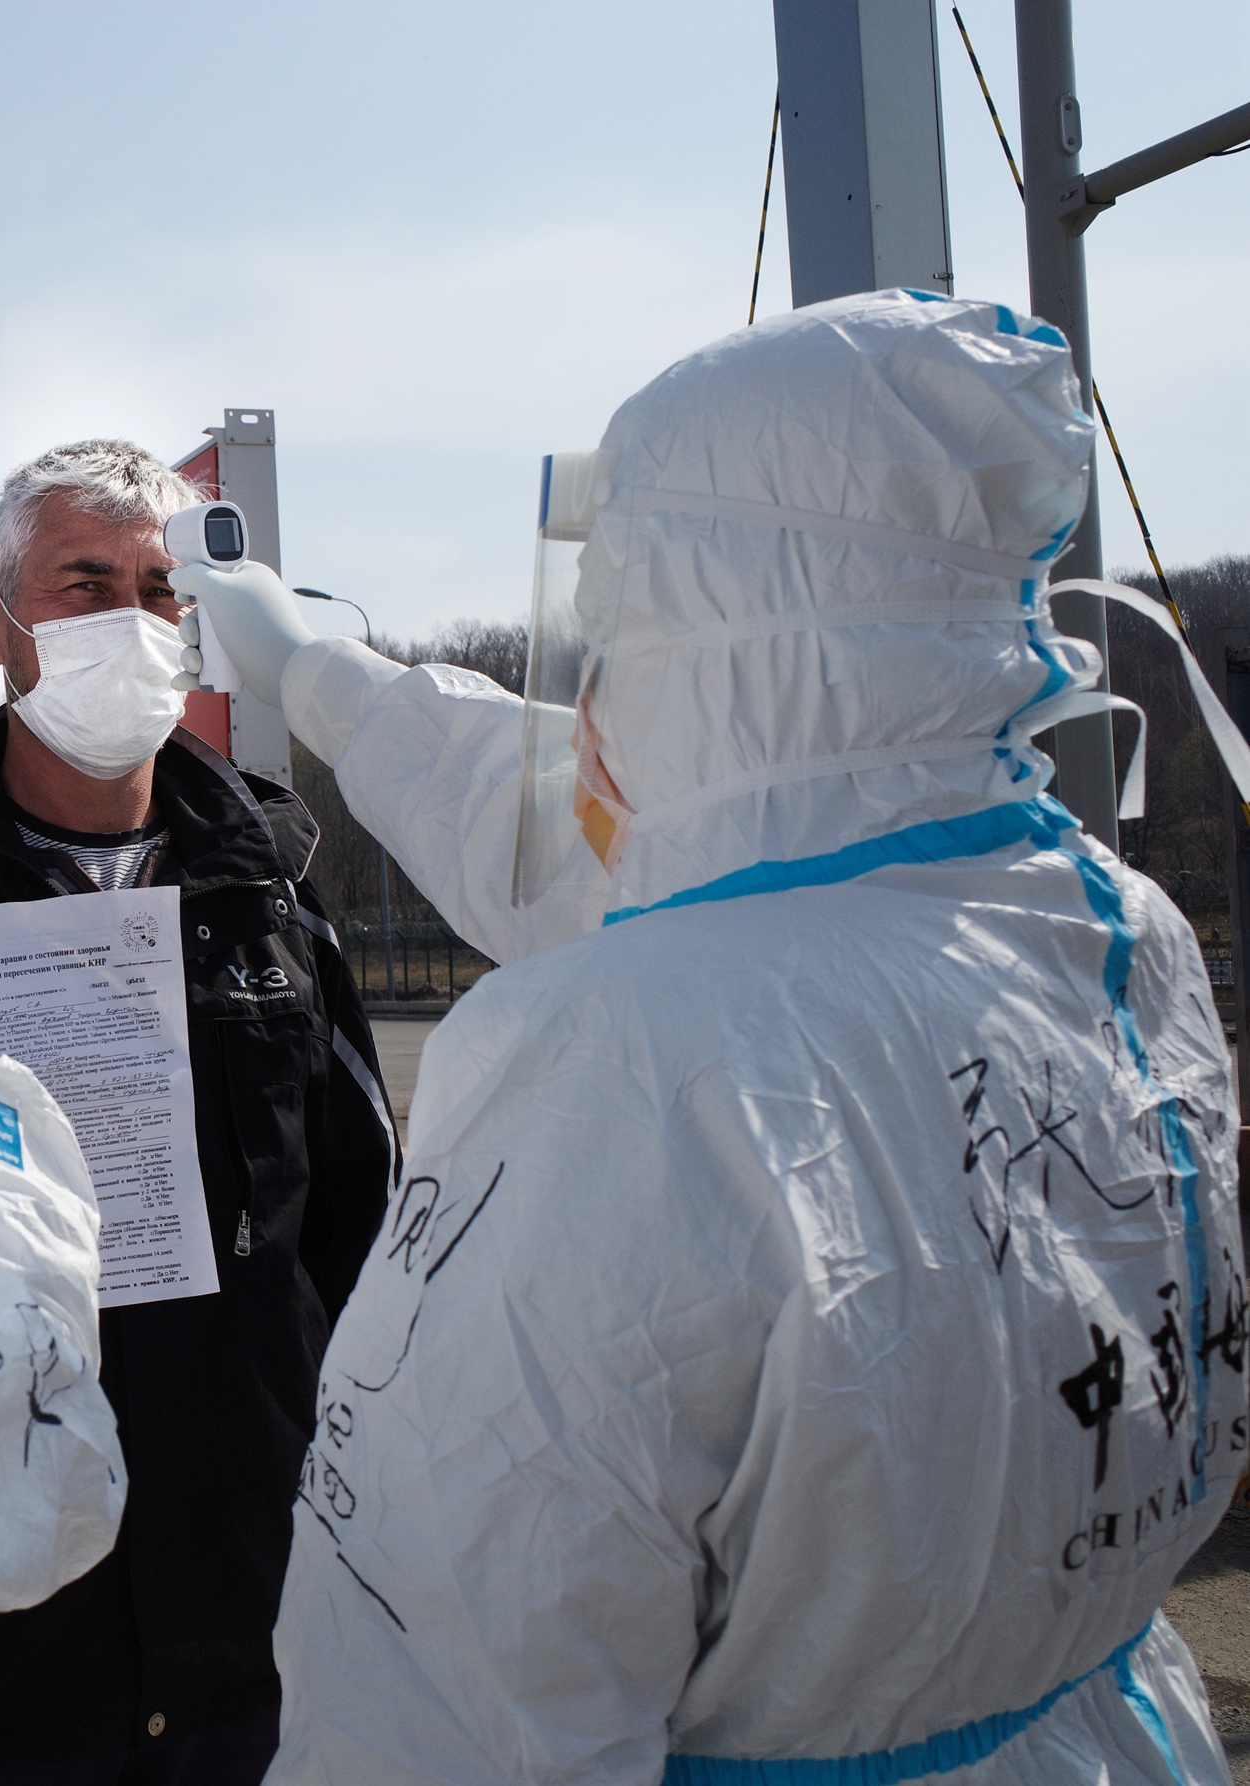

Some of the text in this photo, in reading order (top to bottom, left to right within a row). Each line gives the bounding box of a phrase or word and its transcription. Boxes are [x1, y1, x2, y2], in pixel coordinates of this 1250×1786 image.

[35, 949, 74, 959] состоянии
[77, 945, 110, 955] здоровья
[4, 966, 50, 979] пересечении
[53, 961, 86, 972] границы
[88, 958, 106, 967] КНР
[227, 965, 289, 989] Y-3
[8, 1021, 36, 1029] проживания
[11, 1028, 32, 1036] Паспорт
[38, 1023, 64, 1031] Разрешение
[29, 1045, 53, 1053] Китайской
[54, 1070, 83, 1078] действующий
[154, 1112, 171, 1120] регионы
[117, 1191, 140, 1199] симптомы
[158, 1214, 179, 1222] Насморк
[1062, 1475, 1188, 1571] CHINA
